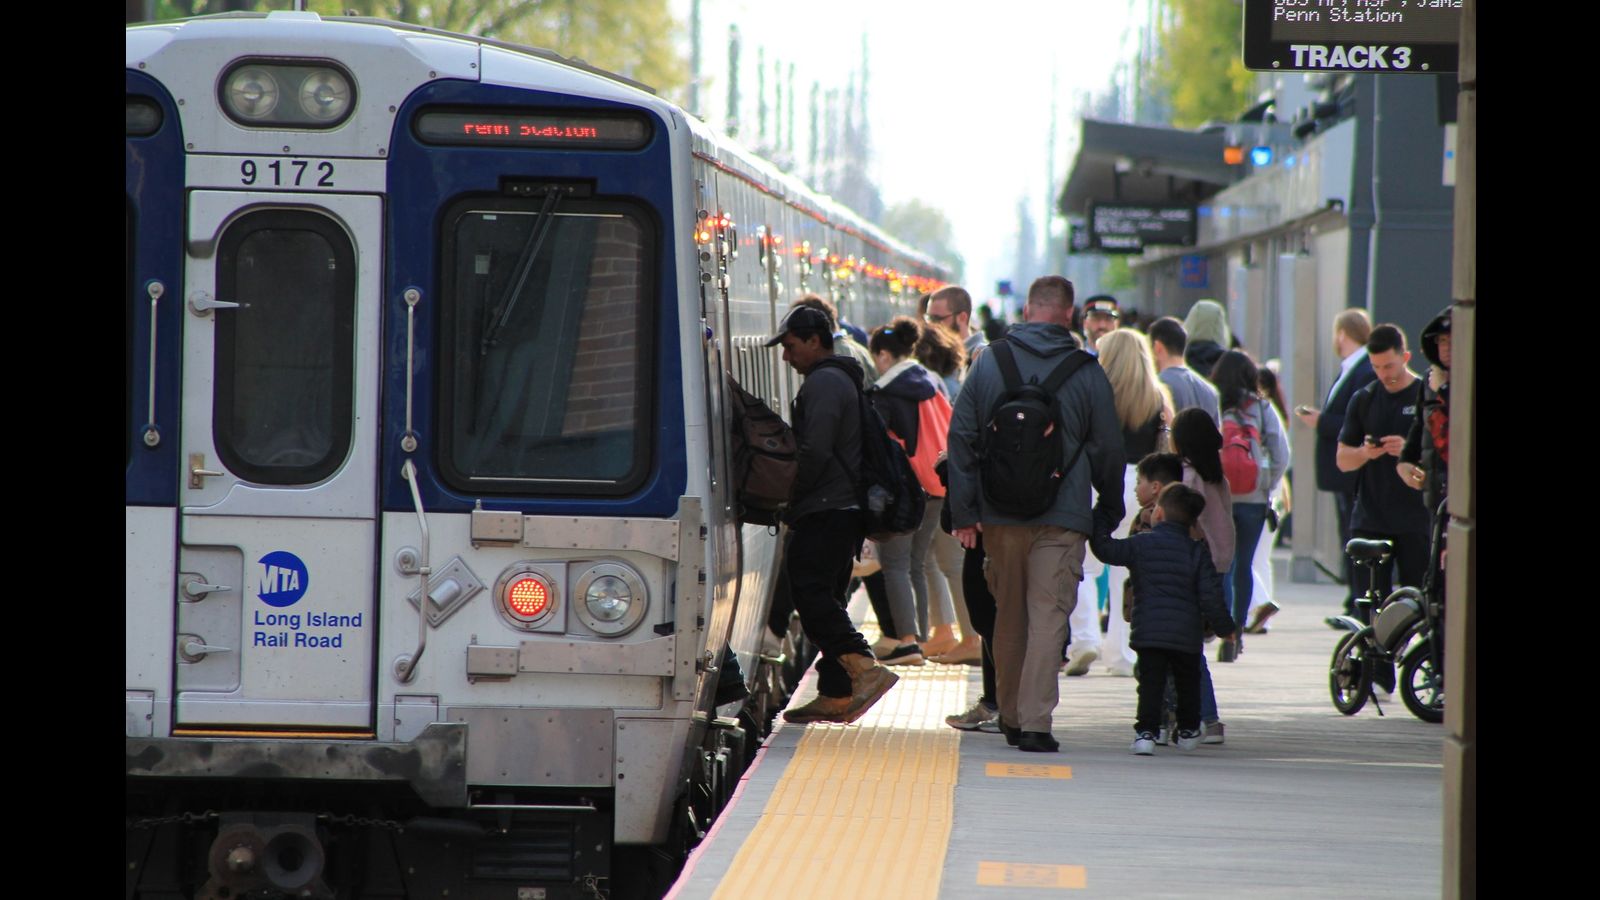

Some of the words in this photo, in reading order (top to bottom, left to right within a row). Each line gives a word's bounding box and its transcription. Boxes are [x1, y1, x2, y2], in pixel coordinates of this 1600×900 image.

[1273, 7, 1320, 22] Penn
[1329, 7, 1403, 23] Station
[1290, 45, 1388, 69] TRACK
[1392, 47, 1412, 69] 3
[240, 159, 335, 187] 9172
[257, 562, 300, 595] MTA
[254, 610, 301, 630] Long
[307, 611, 362, 628] Island
[254, 631, 288, 648] Rail
[294, 632, 342, 648] Road
